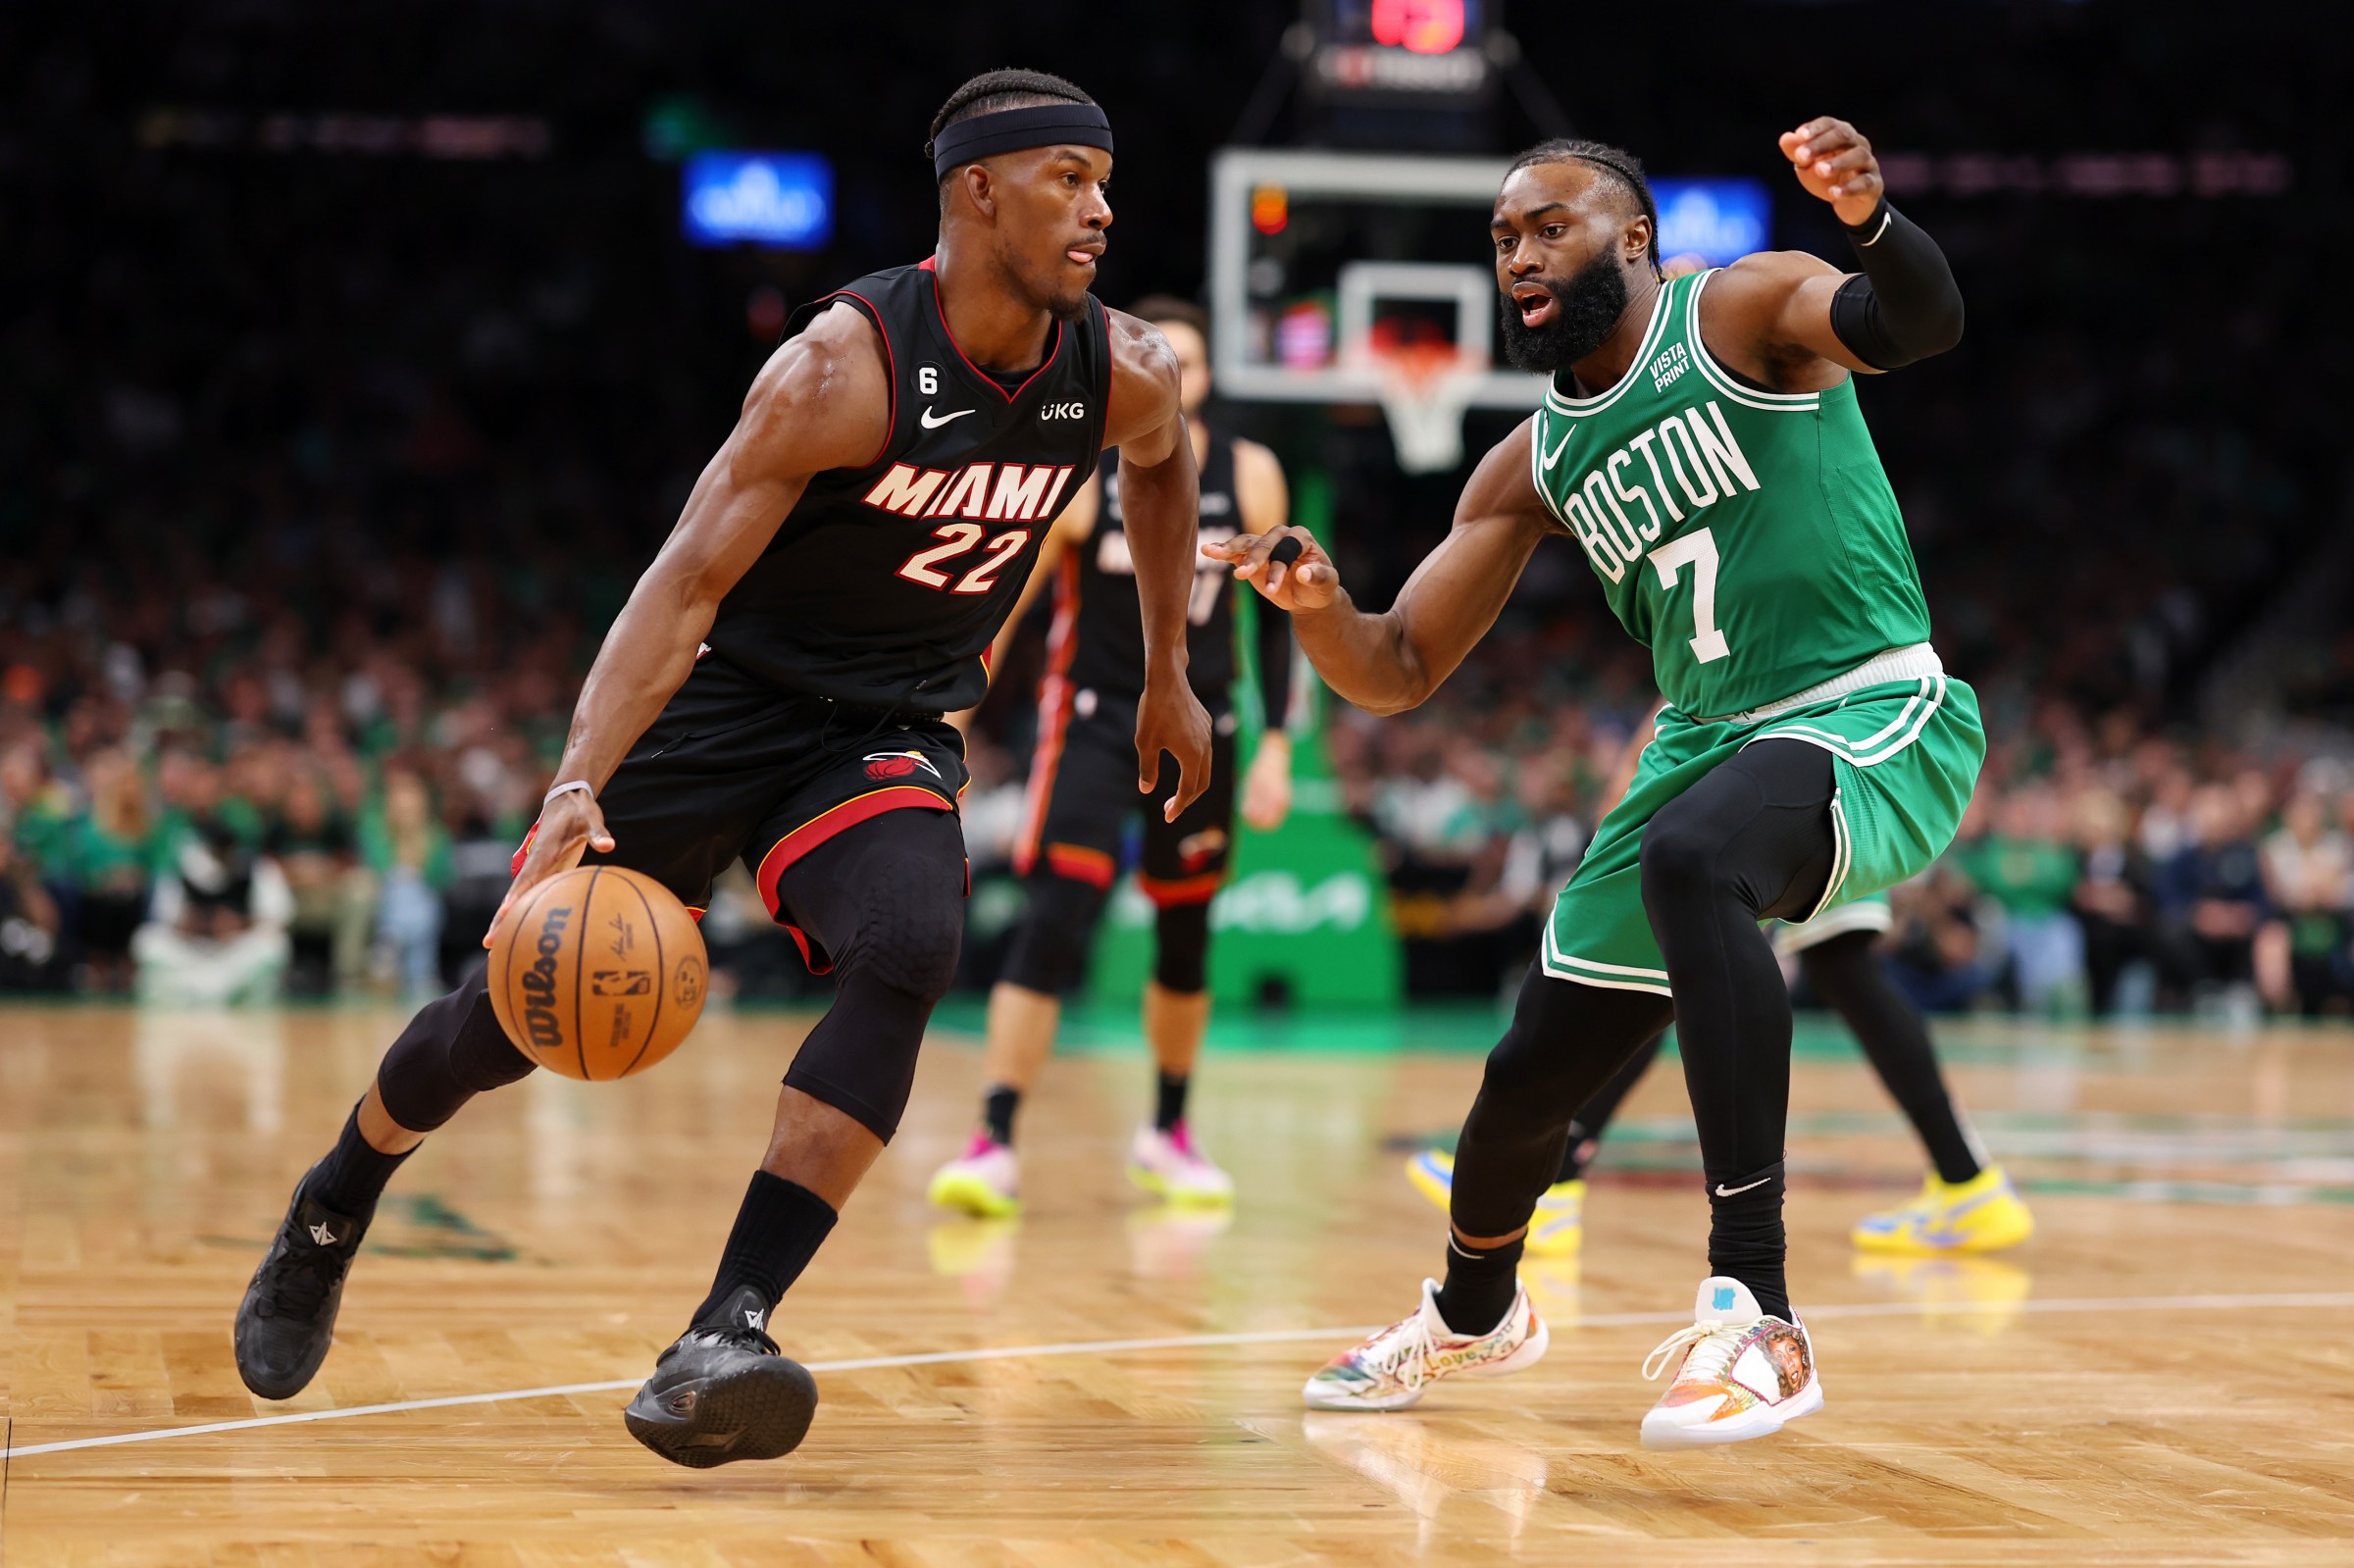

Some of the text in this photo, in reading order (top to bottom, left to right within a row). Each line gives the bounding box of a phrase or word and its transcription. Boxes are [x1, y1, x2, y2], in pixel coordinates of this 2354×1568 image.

[918, 367, 939, 395] 6
[1649, 341, 1687, 379] VISTA
[1655, 355, 1690, 393] PRINT
[860, 461, 1076, 522] MIAMI
[1562, 400, 1762, 585] BOSTON
[894, 522, 1032, 595] 22
[1646, 526, 1731, 665] 7
[521, 905, 574, 1048] Wilson
